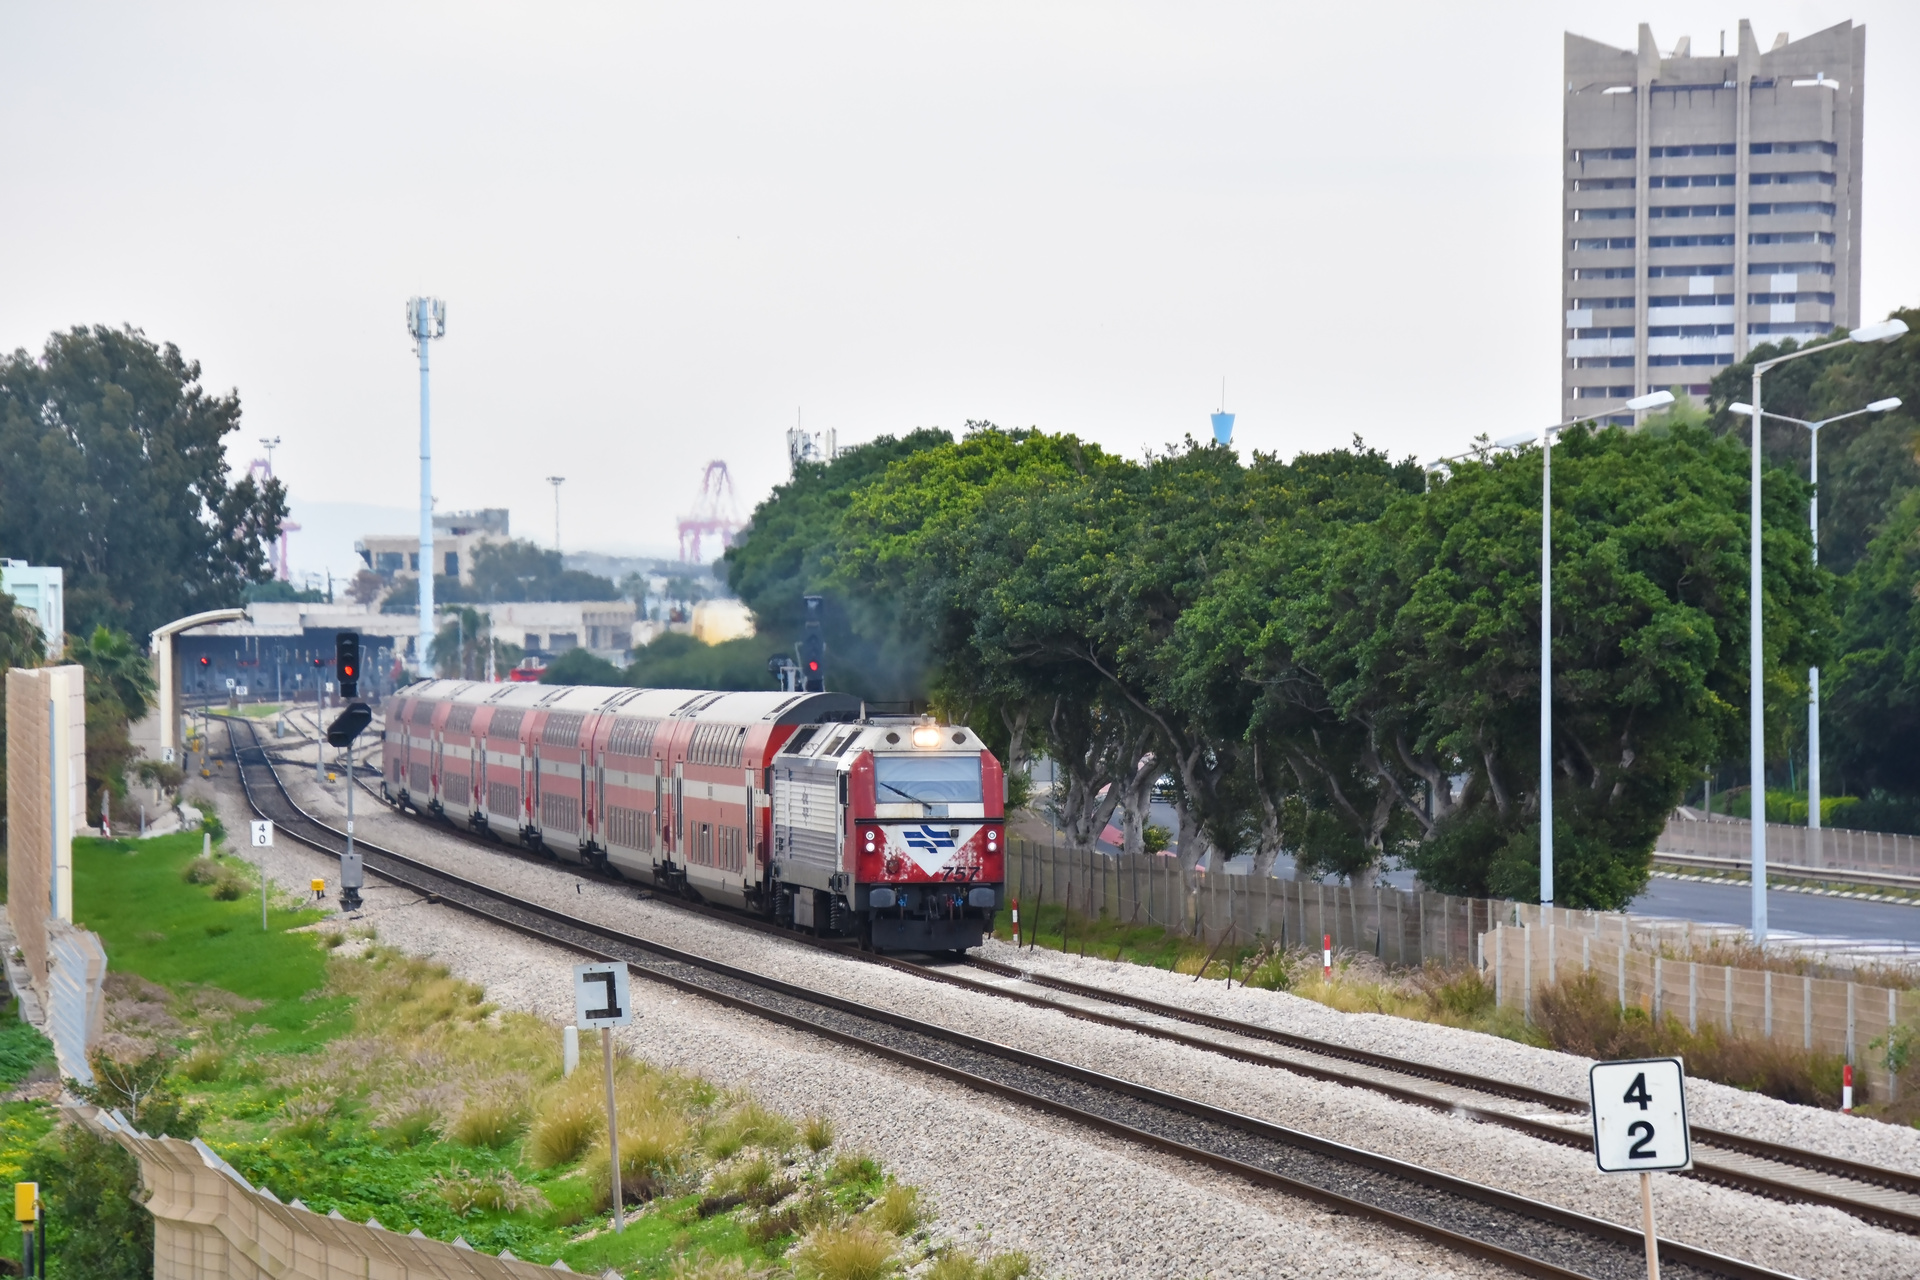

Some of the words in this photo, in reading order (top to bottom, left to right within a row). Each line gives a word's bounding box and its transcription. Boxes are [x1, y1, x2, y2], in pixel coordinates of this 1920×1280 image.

[259, 823, 266, 832] 4
[259, 834, 266, 844] 0
[942, 866, 980, 881] 757
[1623, 1072, 1652, 1110] 4
[1627, 1120, 1657, 1159] 2
